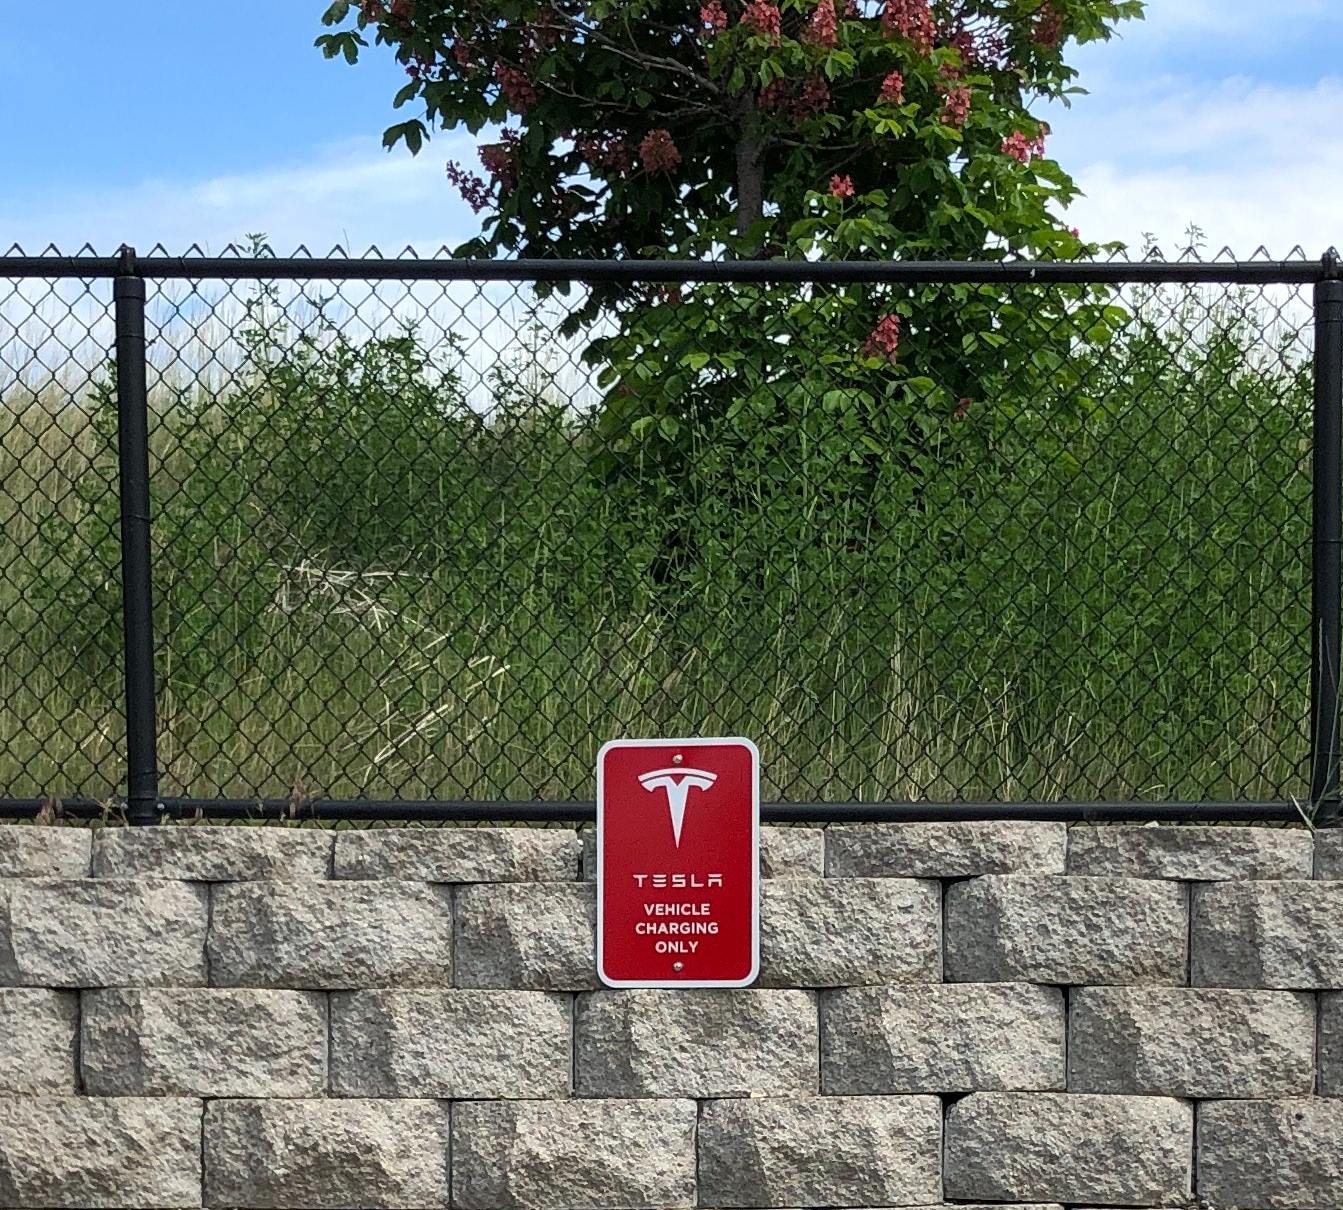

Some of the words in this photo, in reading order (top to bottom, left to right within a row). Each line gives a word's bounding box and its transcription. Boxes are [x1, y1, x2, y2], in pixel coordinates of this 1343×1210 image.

[633, 874, 723, 888] TESLA
[644, 903, 711, 916] VEHICLE
[635, 921, 719, 935] CHARGING
[655, 940, 699, 954] ONLY
